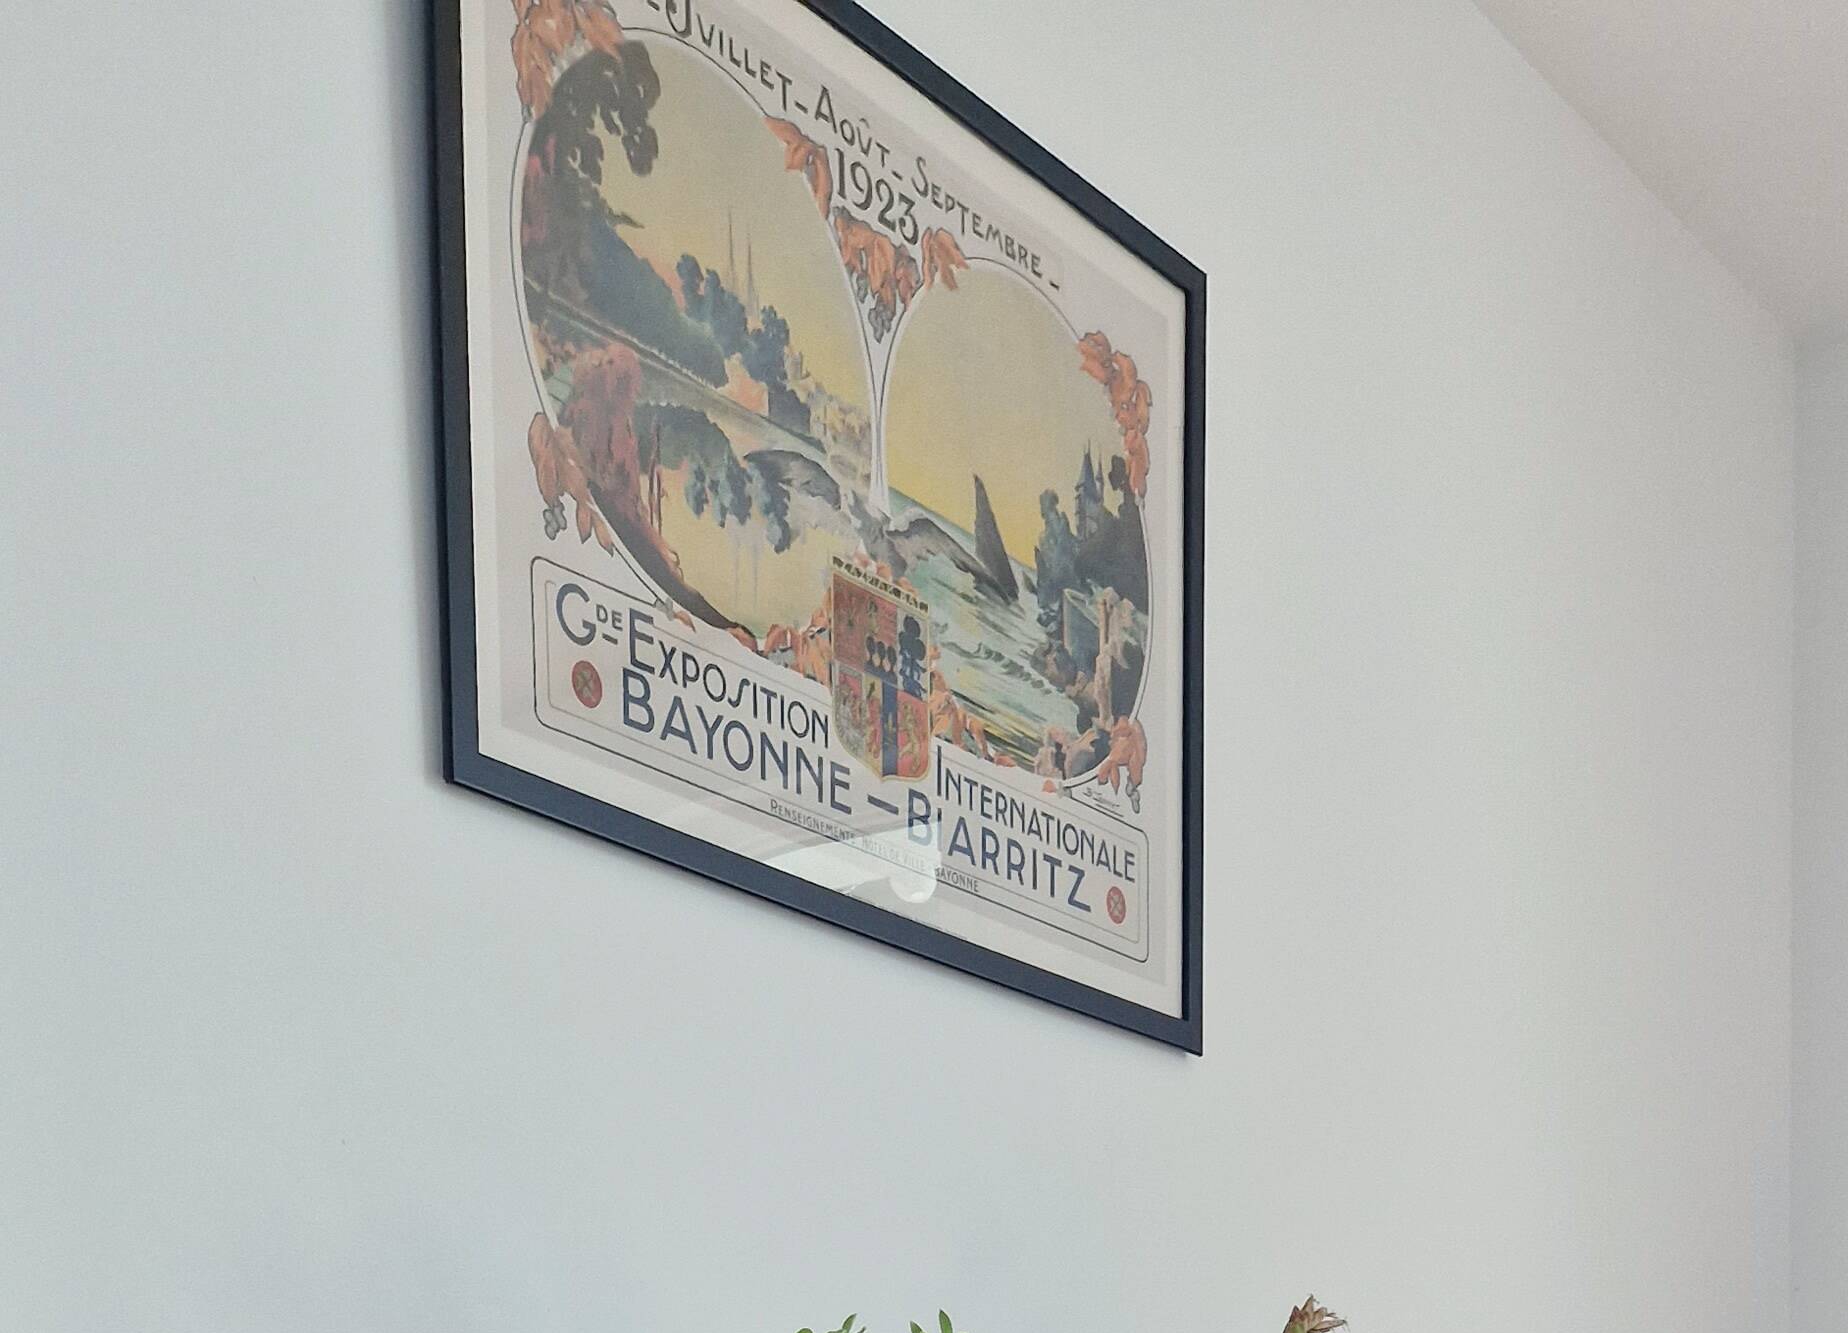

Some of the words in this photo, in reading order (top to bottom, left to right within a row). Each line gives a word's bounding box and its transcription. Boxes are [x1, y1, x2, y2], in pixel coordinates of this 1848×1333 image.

[815, 85, 890, 167] AOÛT
[911, 156, 1043, 279] SEPTEMBRE
[835, 147, 919, 245] 1923
[629, 607, 830, 749] EXPOSITION
[622, 667, 852, 815] BAYONNE
[908, 788, 1091, 912] BIARRITZ
[937, 745, 1136, 884] INTERNATIONALE
